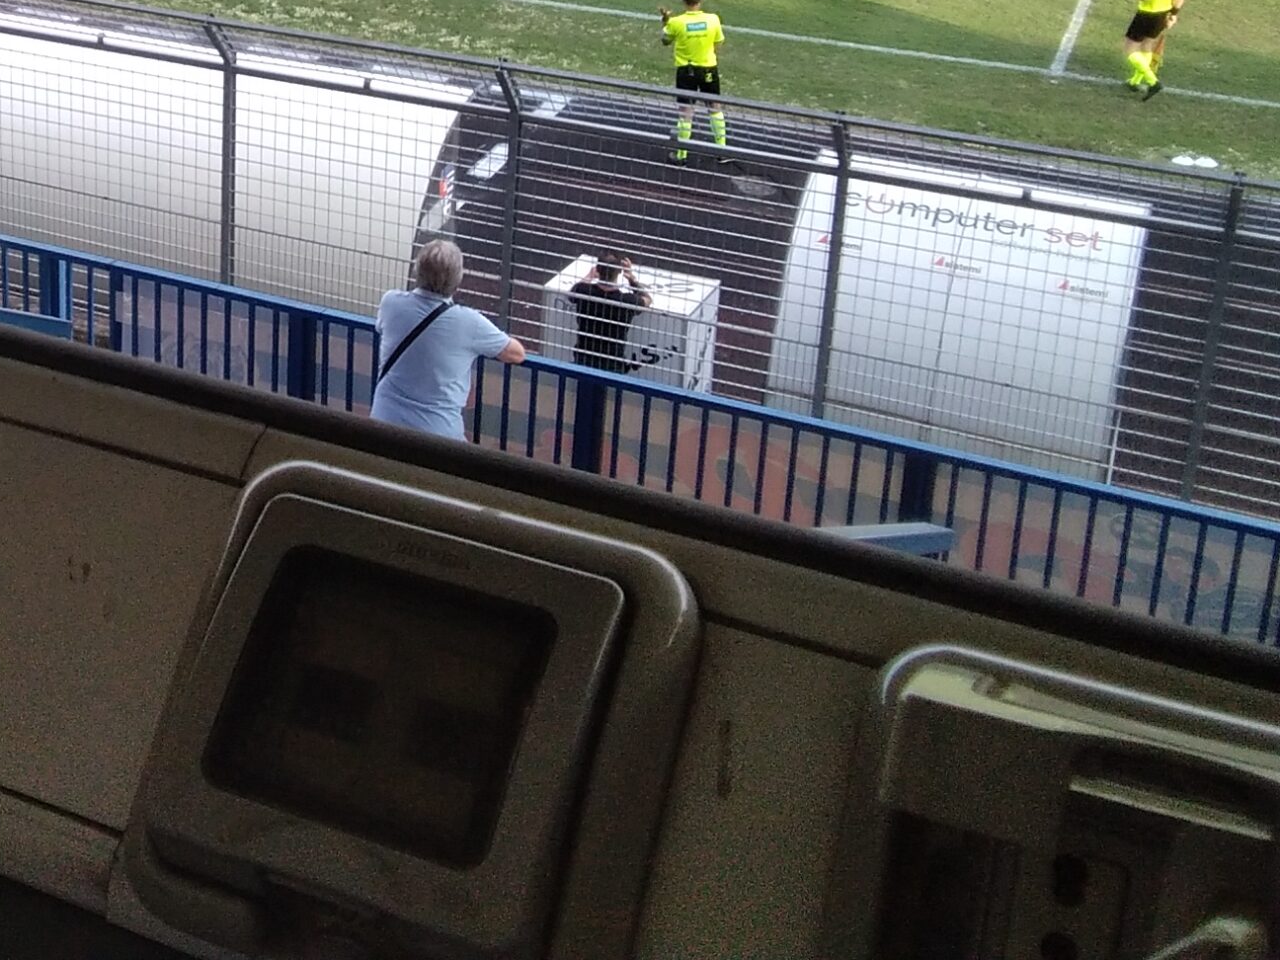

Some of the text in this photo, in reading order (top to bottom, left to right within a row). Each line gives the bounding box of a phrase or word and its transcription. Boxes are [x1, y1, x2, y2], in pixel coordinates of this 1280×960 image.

[846, 191, 1103, 251] computer set
[944, 258, 982, 275] sistemi
[1070, 284, 1109, 299] sistemi
